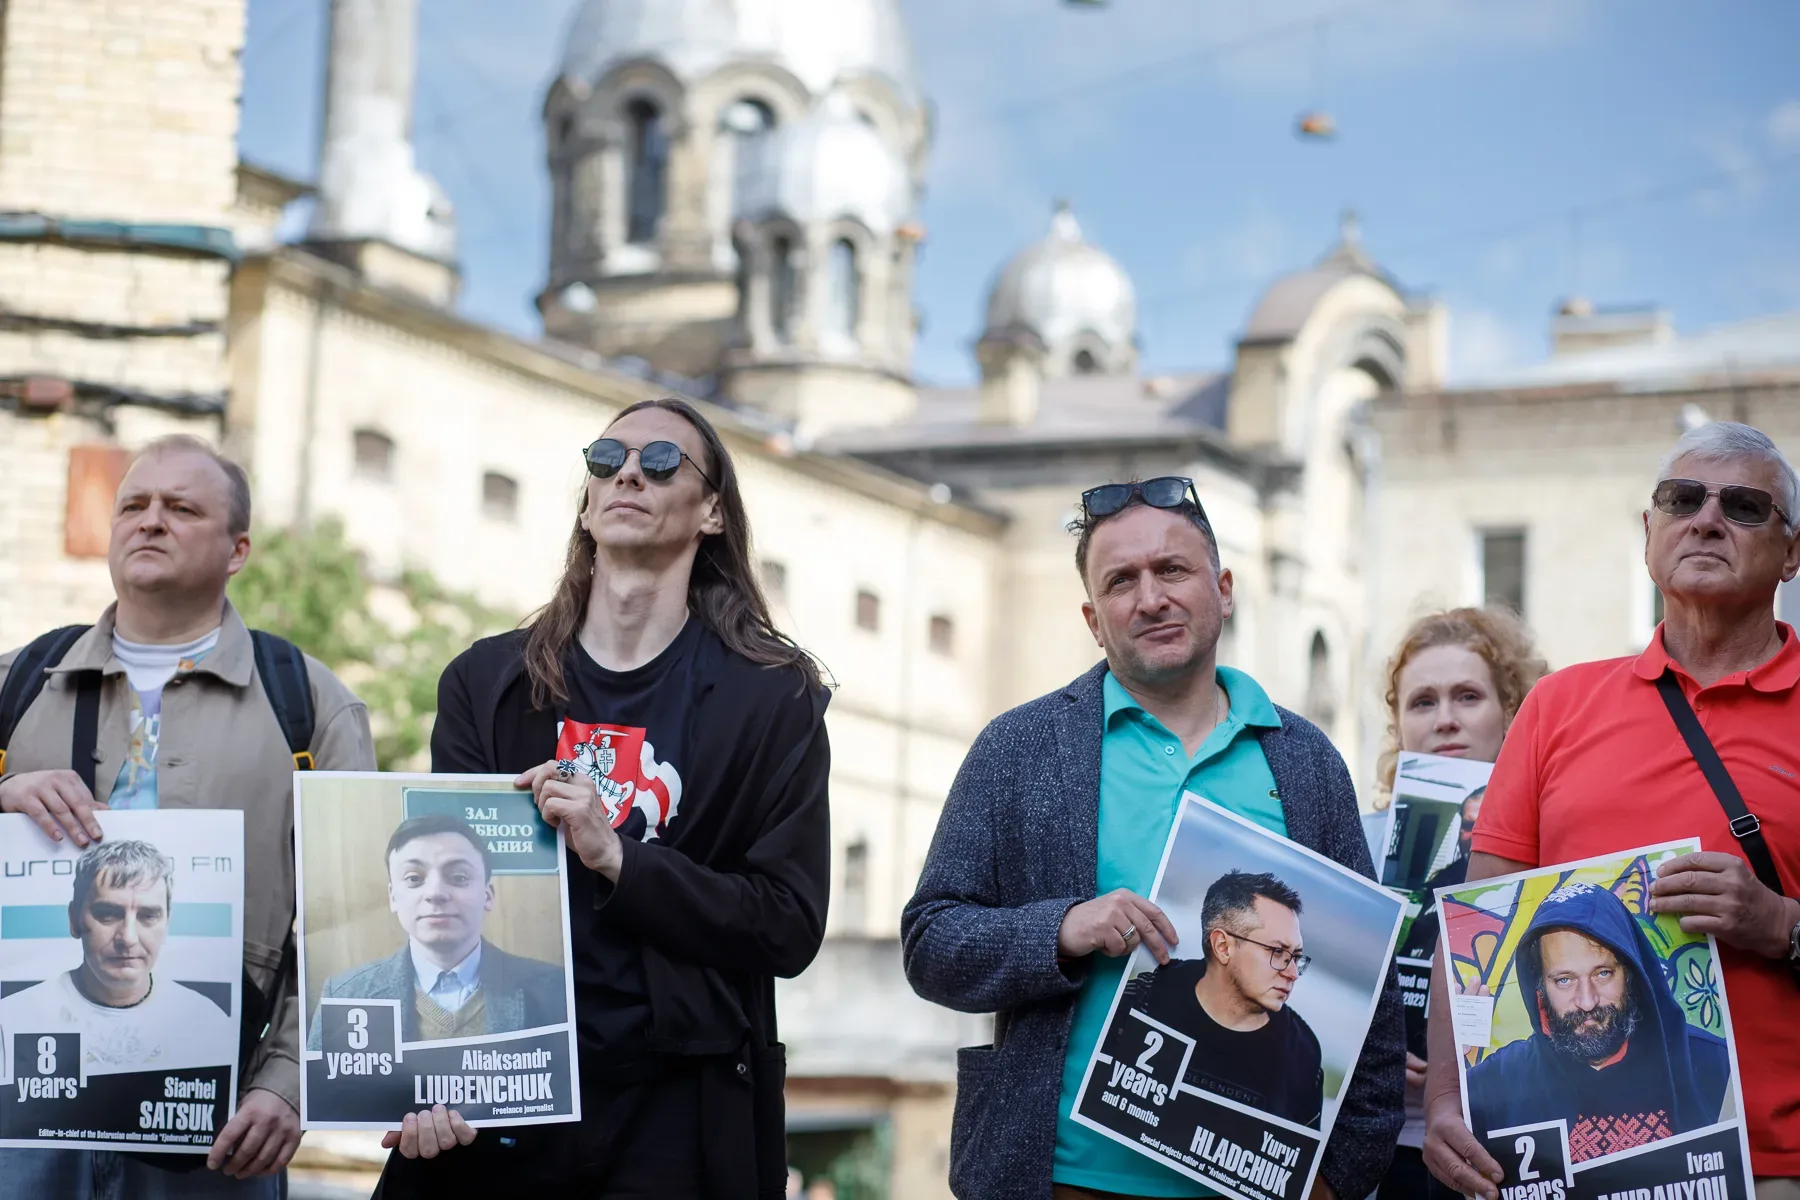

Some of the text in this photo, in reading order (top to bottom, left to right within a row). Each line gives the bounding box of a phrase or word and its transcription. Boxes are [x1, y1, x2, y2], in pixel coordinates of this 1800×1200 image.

[465, 806, 498, 820] ЗАЛ
[469, 824, 533, 837] БНОГО
[1416, 977, 1429, 990] on
[1403, 991, 1426, 1008] 2023
[347, 1008, 369, 1050] 3
[37, 1035, 57, 1075] 8
[326, 1052, 393, 1080] years
[461, 1048, 552, 1071] Aliaksandr
[1135, 1030, 1164, 1074] 2
[17, 1077, 78, 1103] years
[164, 1076, 216, 1100] Siarhei
[414, 1072, 554, 1105] LIUBENCHUK
[1107, 1060, 1169, 1106] years
[139, 1100, 215, 1132] SATSUK
[492, 1103, 555, 1115] Freelance journalist
[1101, 1090, 1160, 1127] and 6 months
[38, 1128, 80, 1138] Editor-in-chief
[80, 1129, 87, 1138] of
[87, 1130, 96, 1139] the
[96, 1130, 125, 1140] Belarusian
[1140, 1132, 1161, 1149] Special
[1158, 1143, 1183, 1160] projects
[1181, 1154, 1200, 1168] editor
[1198, 1162, 1206, 1172] of
[1189, 1125, 1293, 1198] HLADCHUK
[1260, 1130, 1301, 1168] Yuryi
[1514, 1135, 1540, 1181] 2
[1686, 1151, 1725, 1175] Ivan
[1597, 1174, 1730, 1200] UYOU
